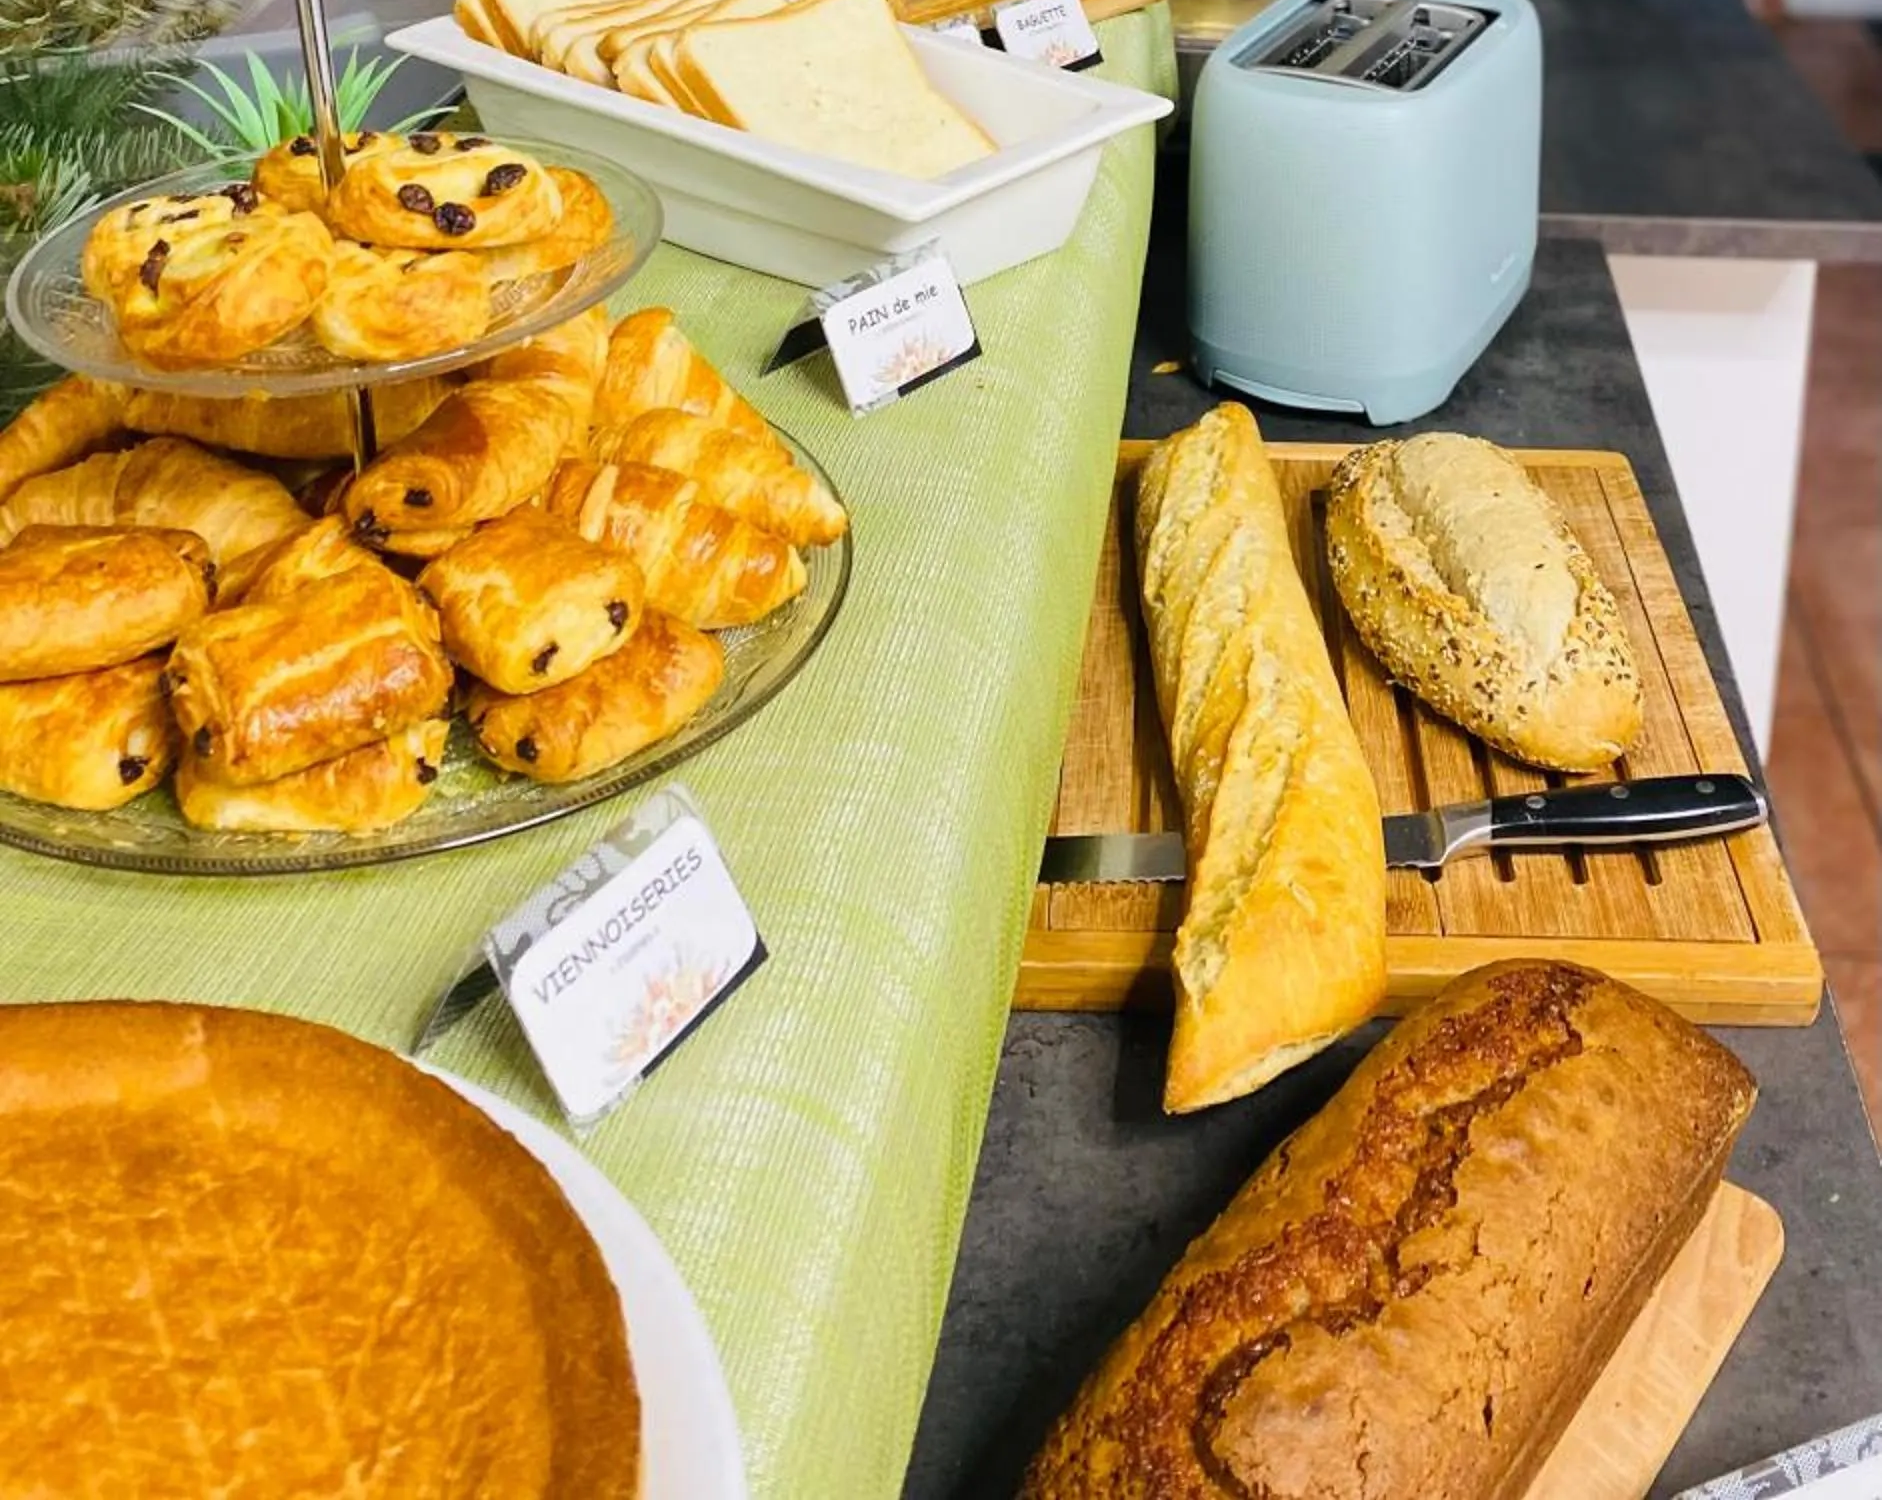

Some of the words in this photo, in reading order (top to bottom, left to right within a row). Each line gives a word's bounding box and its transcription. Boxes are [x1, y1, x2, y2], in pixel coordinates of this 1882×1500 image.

[1015, 5, 1067, 30] BAGUETTE
[848, 309, 889, 335] PAIN
[893, 297, 911, 314] de
[915, 284, 938, 303] mie
[533, 847, 703, 1004] VIENNOISERIES
